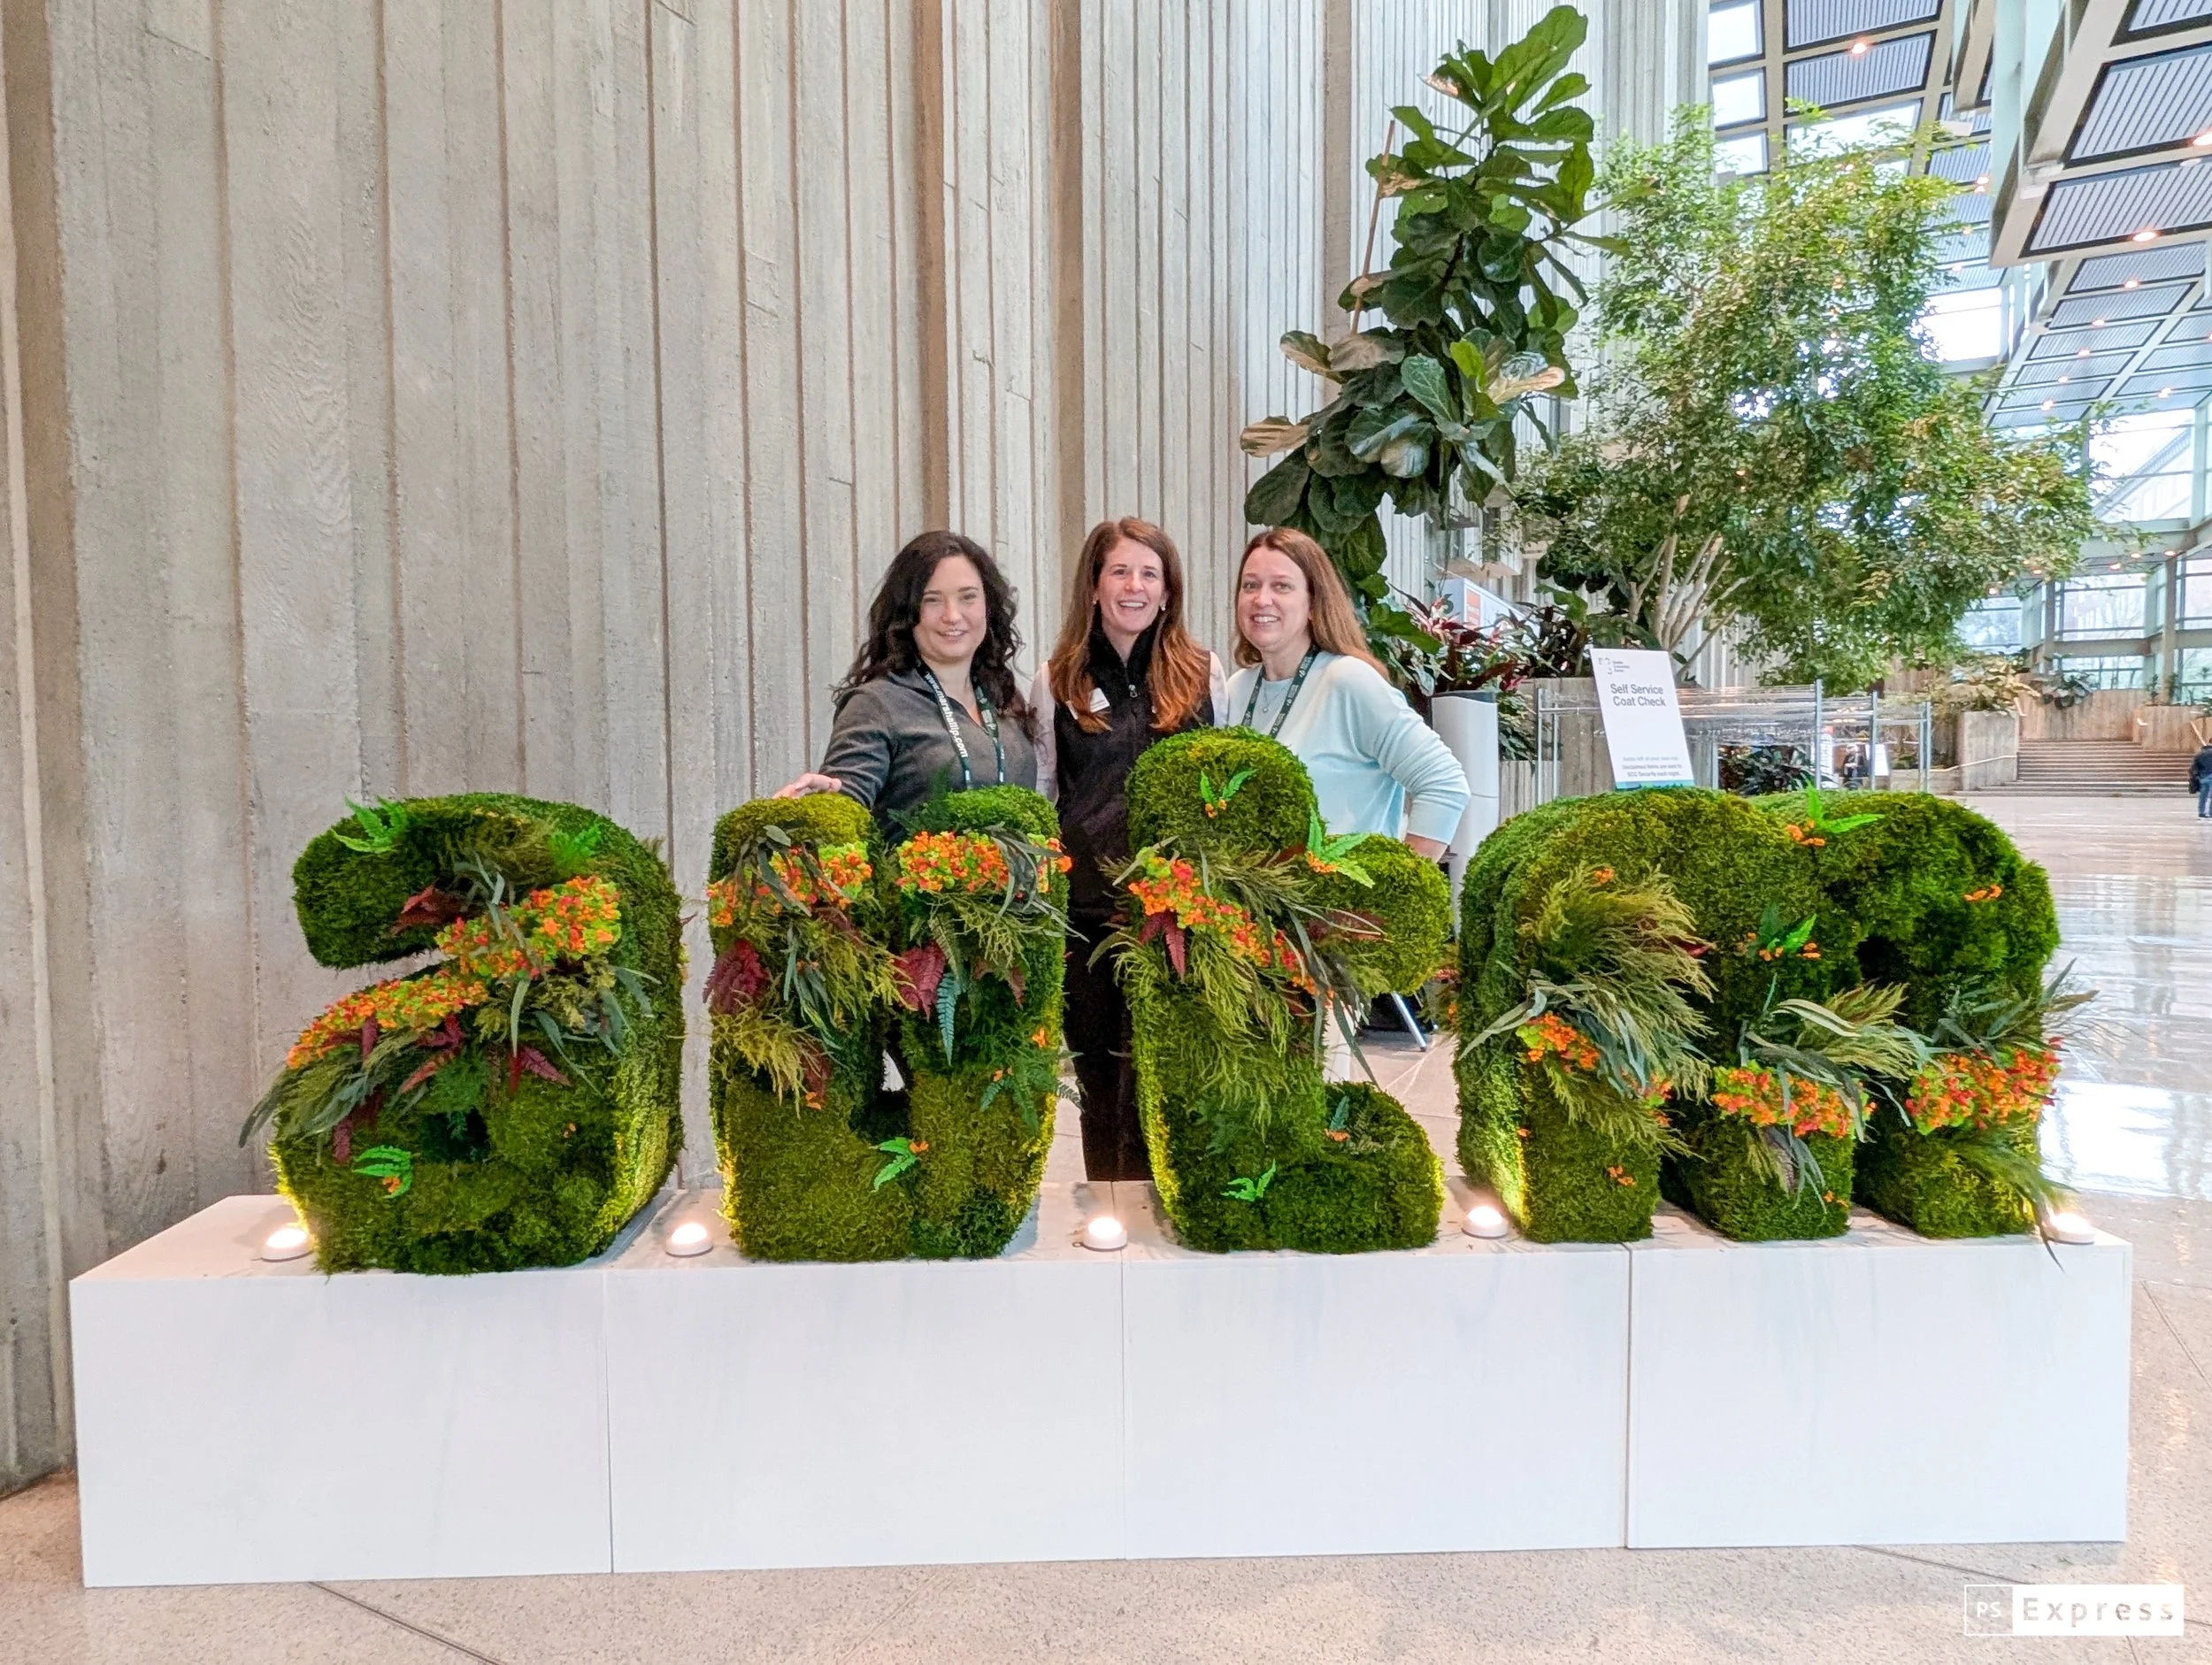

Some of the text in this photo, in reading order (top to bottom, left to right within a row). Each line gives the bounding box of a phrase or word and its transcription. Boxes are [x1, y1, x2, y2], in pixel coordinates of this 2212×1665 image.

[1609, 683, 1663, 694] Self Service
[1613, 695, 1667, 707] Coat Check
[924, 671, 969, 758] www.marshallip.com
